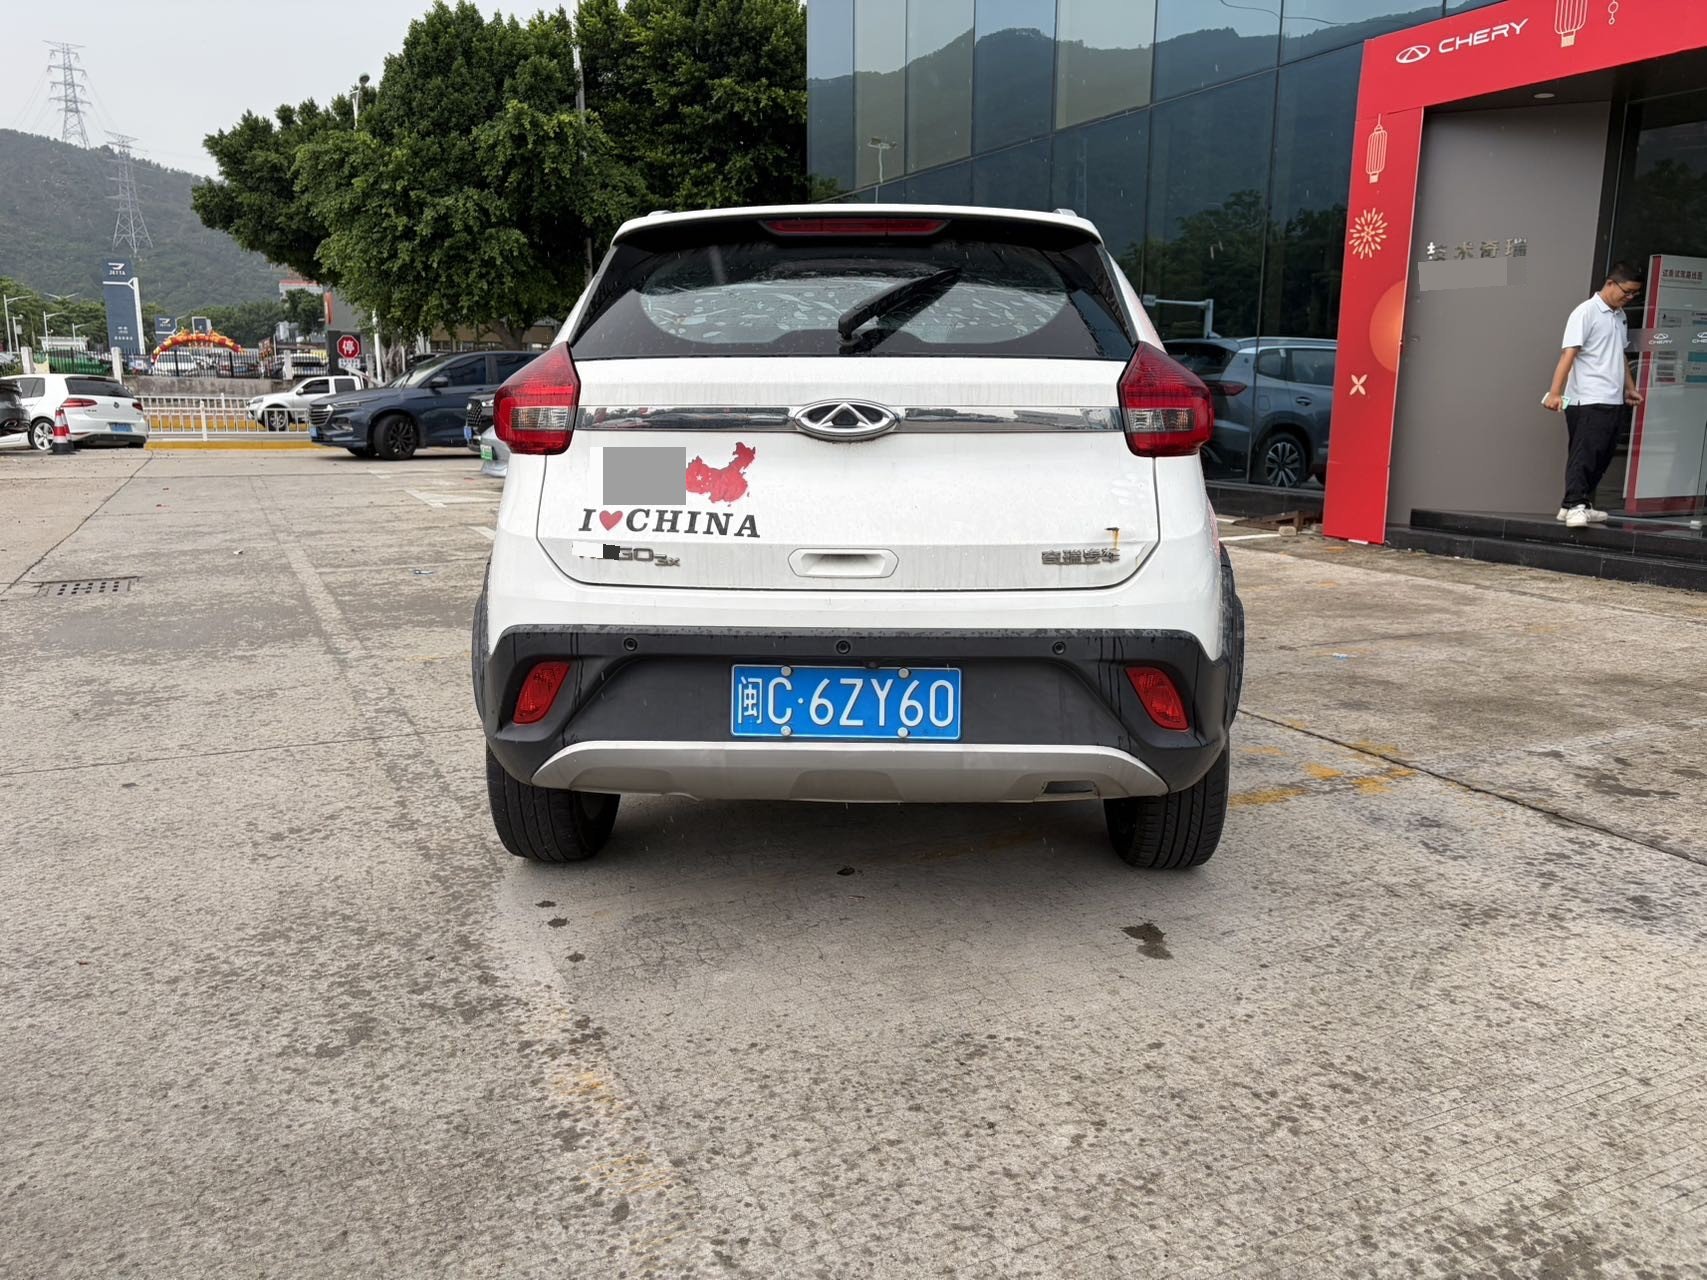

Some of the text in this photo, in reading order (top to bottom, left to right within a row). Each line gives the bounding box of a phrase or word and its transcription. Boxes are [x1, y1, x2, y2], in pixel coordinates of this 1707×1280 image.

[1438, 18, 1529, 54] CHERY
[342, 340, 355, 354] 停
[578, 508, 761, 539] I CHINA
[1041, 548, 1121, 566] 奇瑞汽车
